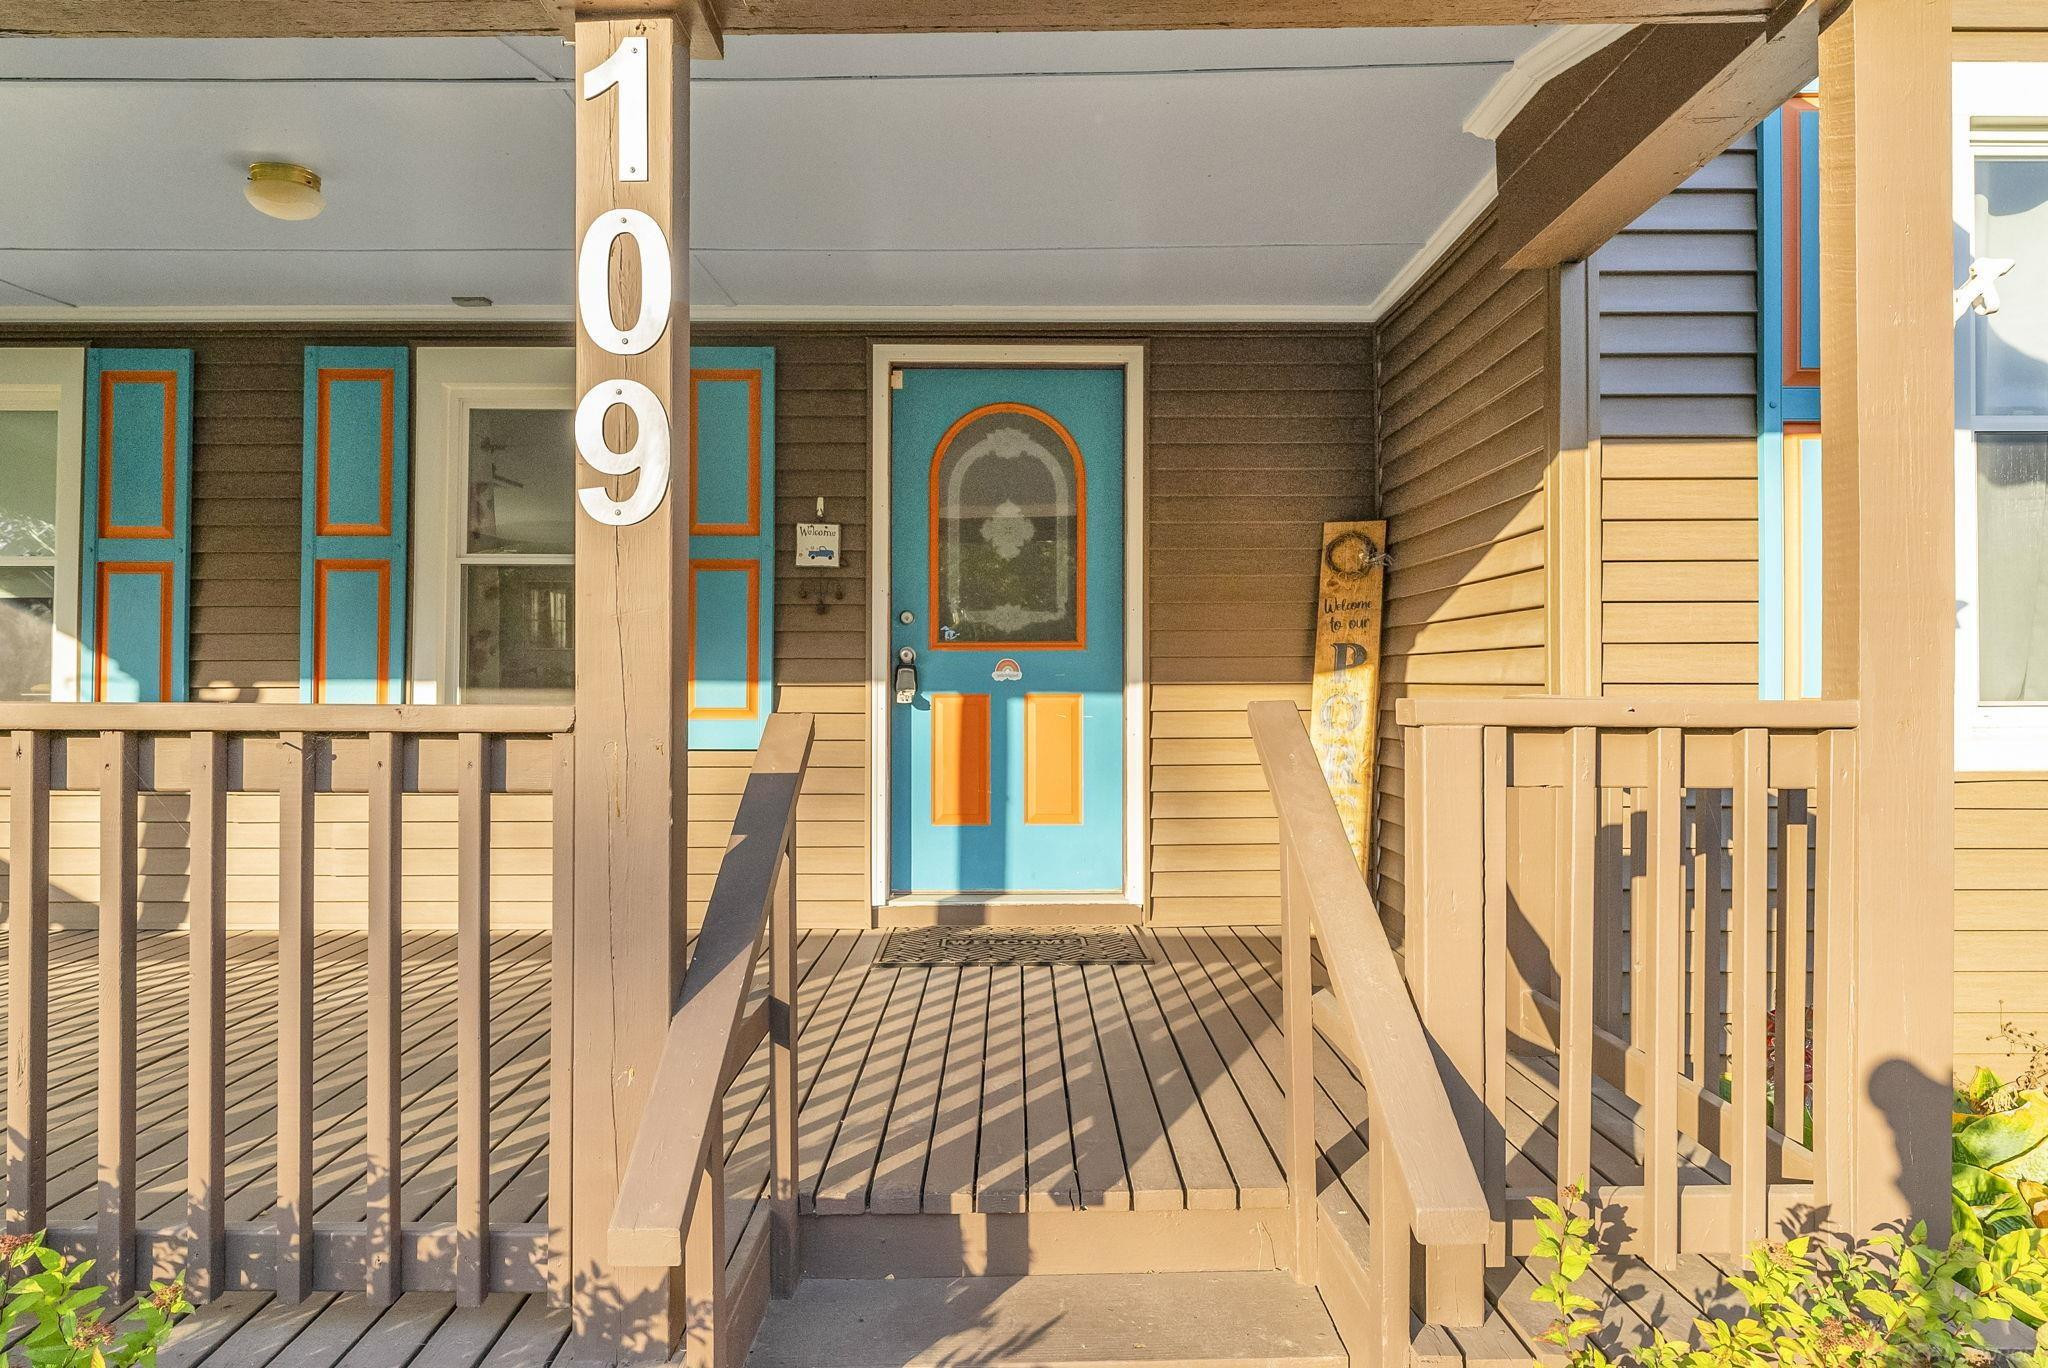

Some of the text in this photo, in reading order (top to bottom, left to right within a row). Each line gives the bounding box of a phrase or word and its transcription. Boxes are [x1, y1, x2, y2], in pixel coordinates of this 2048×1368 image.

[575, 36, 672, 527] 109
[799, 525, 837, 537] Welcome
[1324, 598, 1372, 614] Welcome
[1329, 617, 1370, 633] to our
[949, 937, 1080, 947] WELCOME
